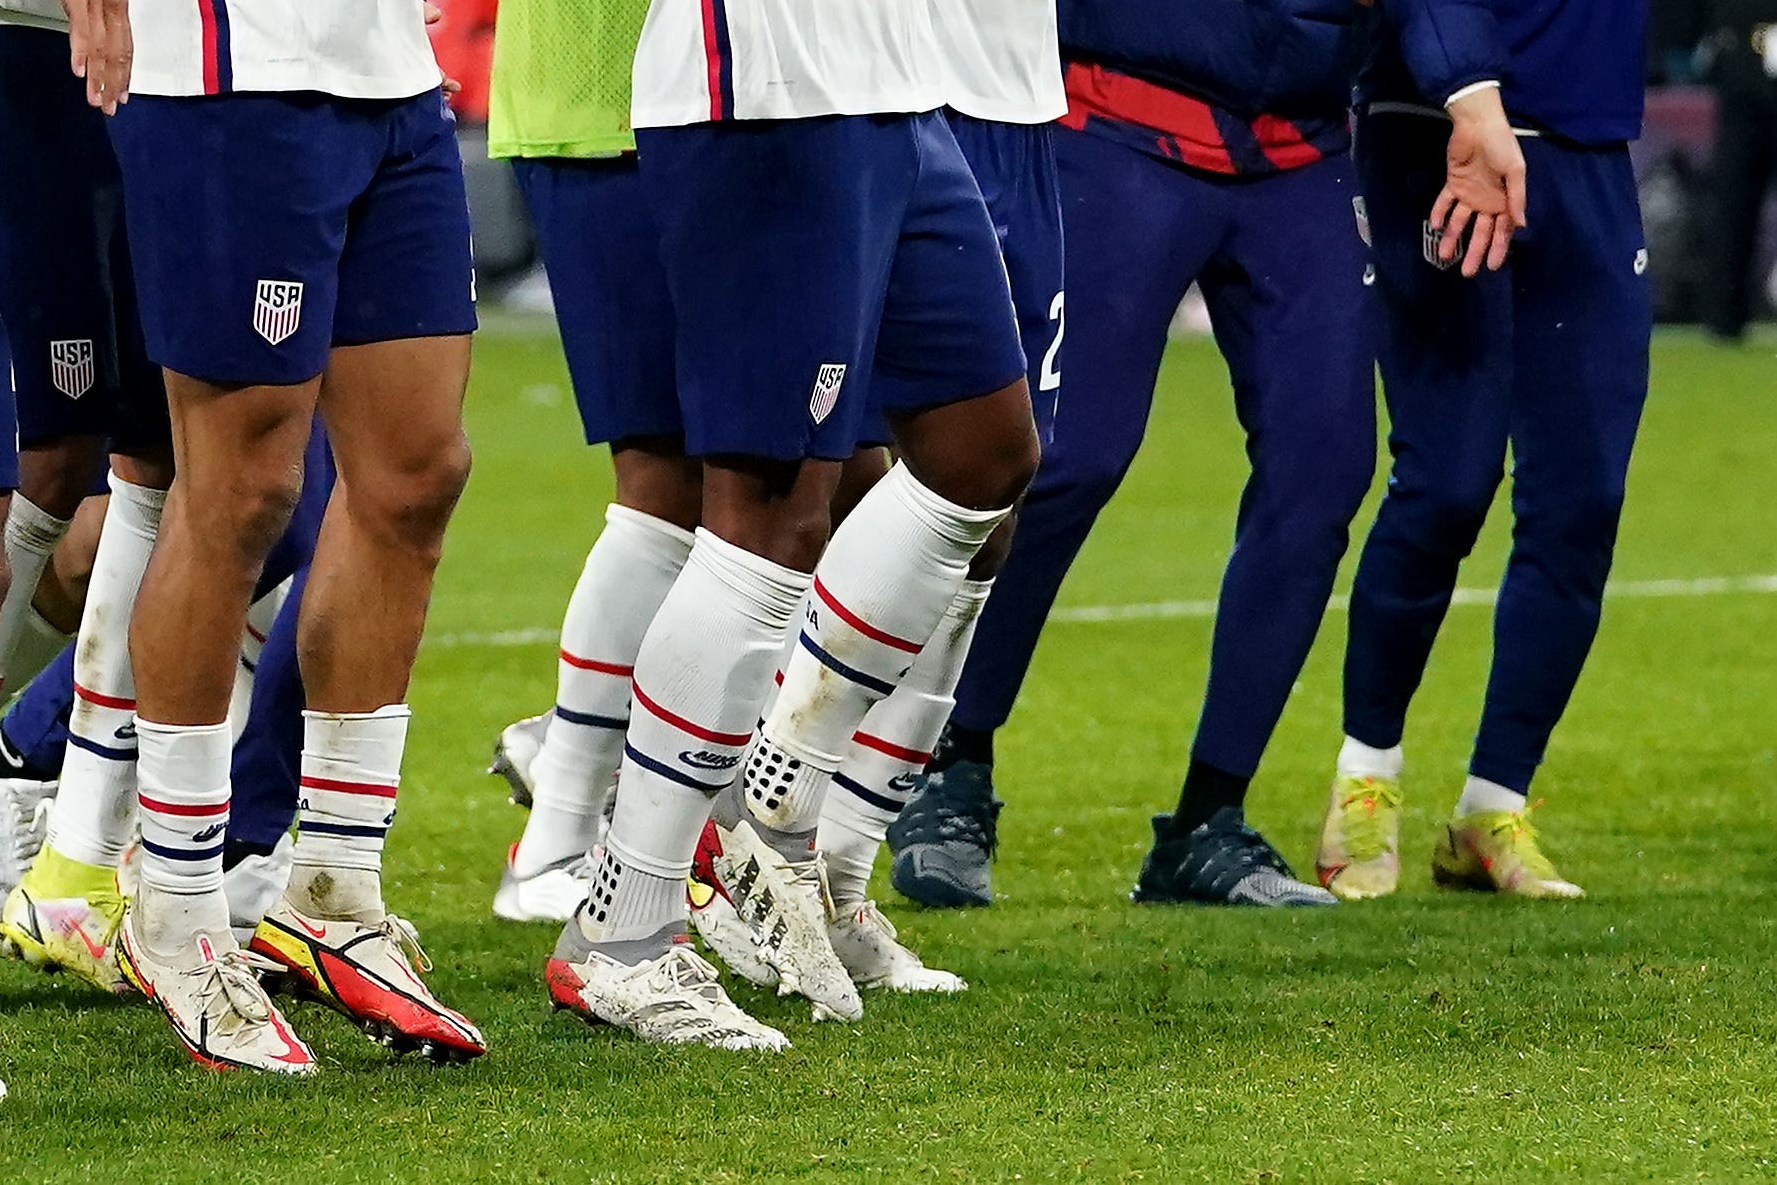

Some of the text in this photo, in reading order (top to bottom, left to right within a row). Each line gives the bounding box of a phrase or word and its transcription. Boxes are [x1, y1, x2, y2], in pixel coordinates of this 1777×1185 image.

[259, 282, 301, 308] USA
[52, 341, 91, 366] USA
[820, 367, 844, 390] USA
